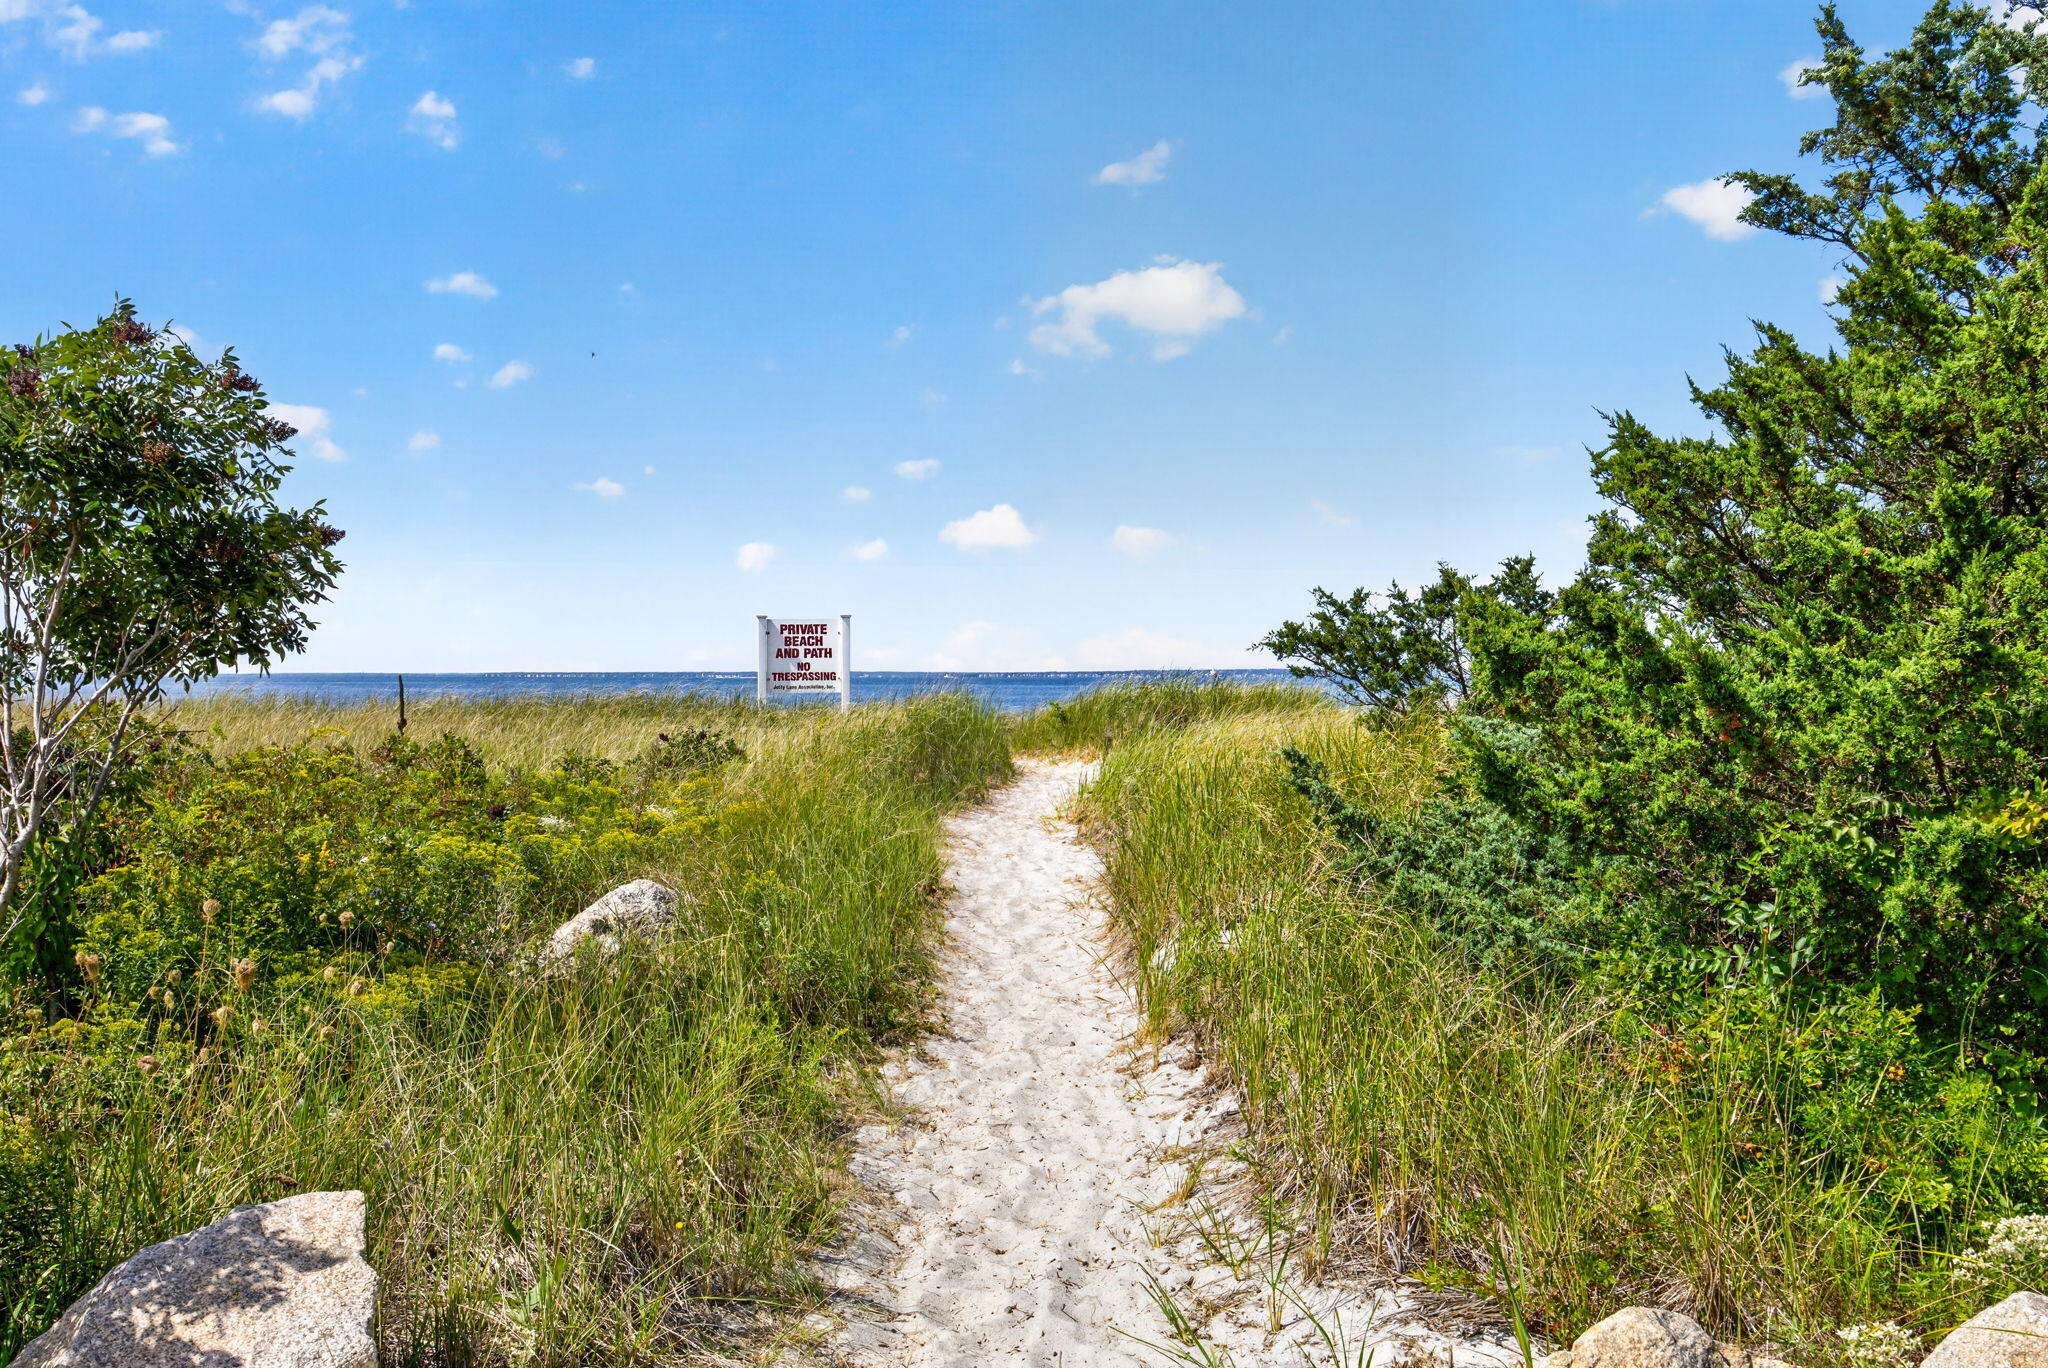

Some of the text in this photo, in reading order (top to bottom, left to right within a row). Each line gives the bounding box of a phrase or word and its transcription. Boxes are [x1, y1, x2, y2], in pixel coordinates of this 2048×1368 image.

[780, 624, 827, 635] PRIVATE
[784, 636, 823, 647] BEACH
[775, 648, 832, 658] AND PATH
[797, 662, 811, 671] NO
[772, 672, 837, 681] TRESPASSING
